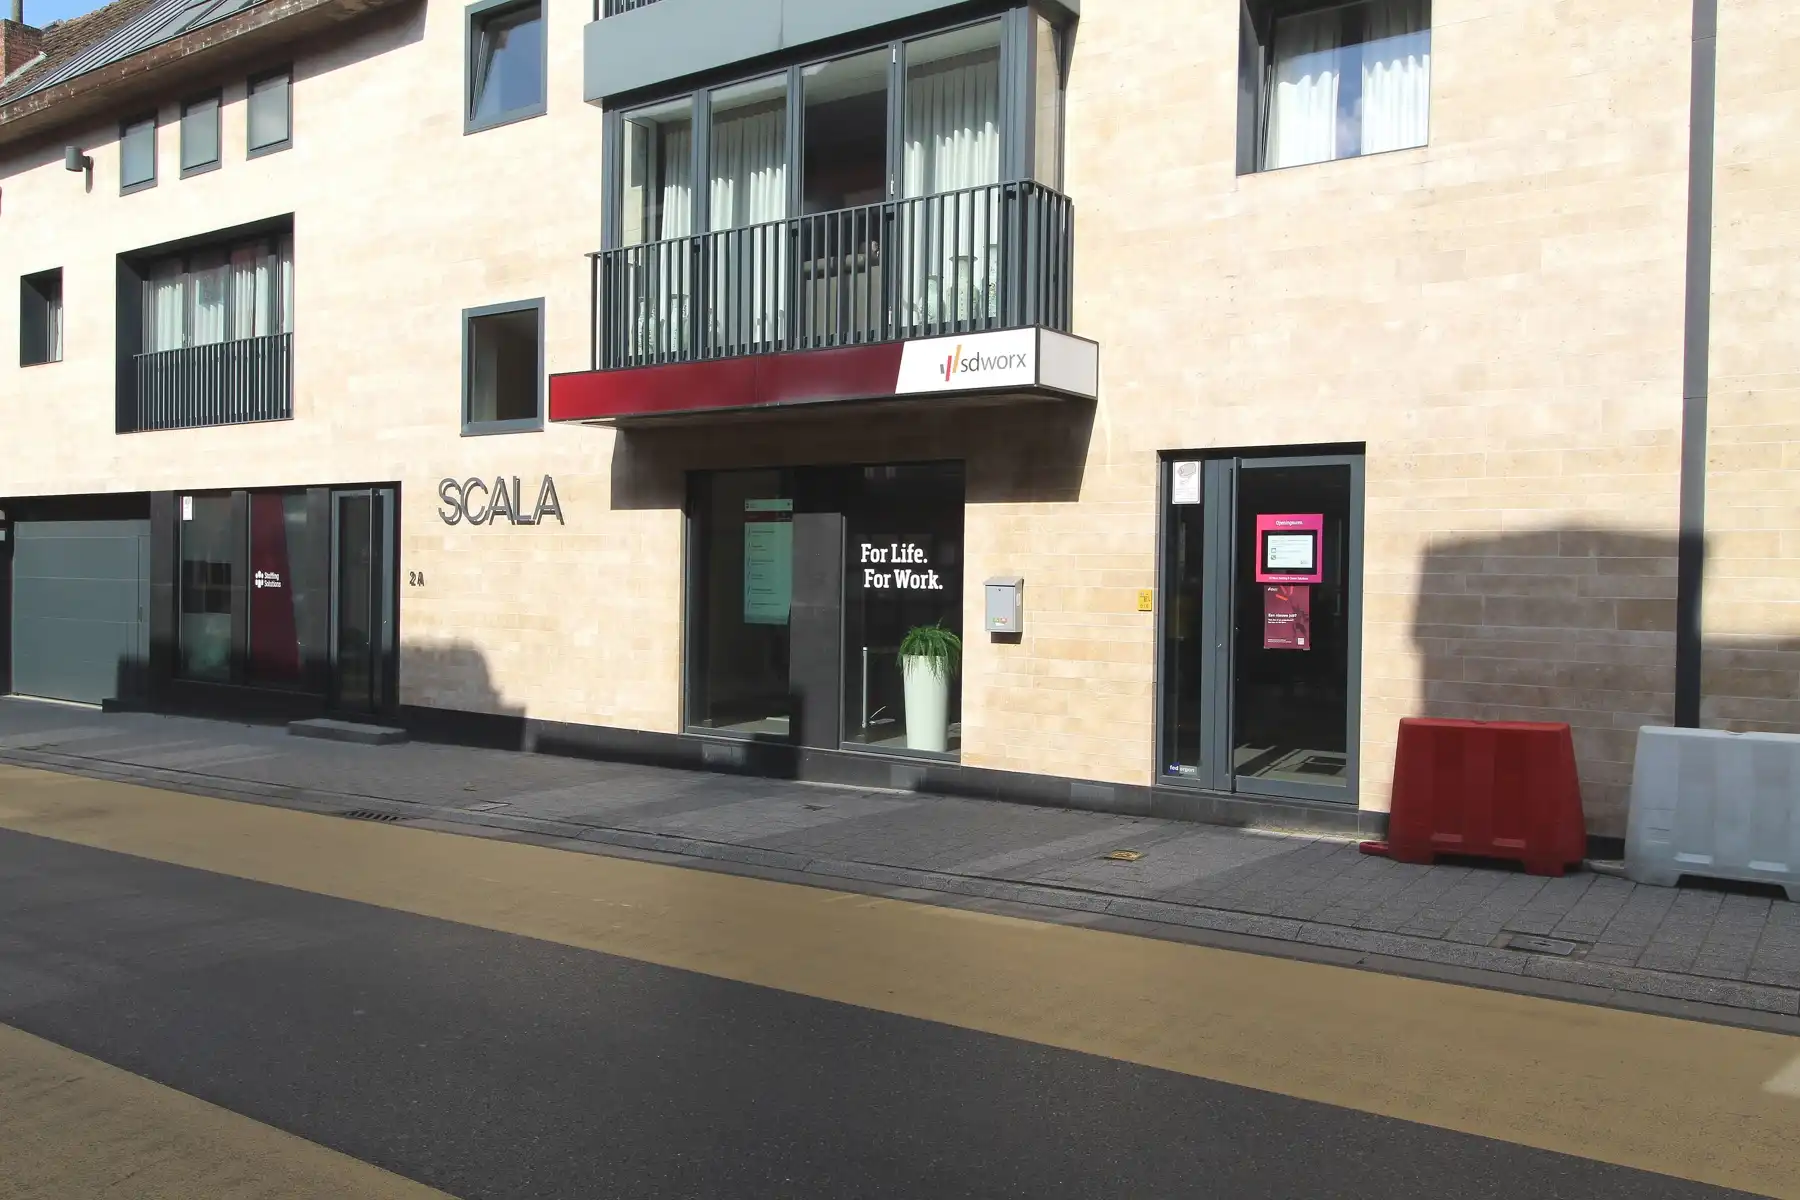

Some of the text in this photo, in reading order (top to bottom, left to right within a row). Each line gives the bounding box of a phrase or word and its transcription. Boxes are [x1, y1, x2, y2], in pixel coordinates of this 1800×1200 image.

[960, 351, 1027, 373] sdworx
[438, 474, 565, 526] SCALA
[860, 543, 928, 563] For Life.
[409, 571, 425, 587] 2A
[863, 568, 943, 590] For Work.
